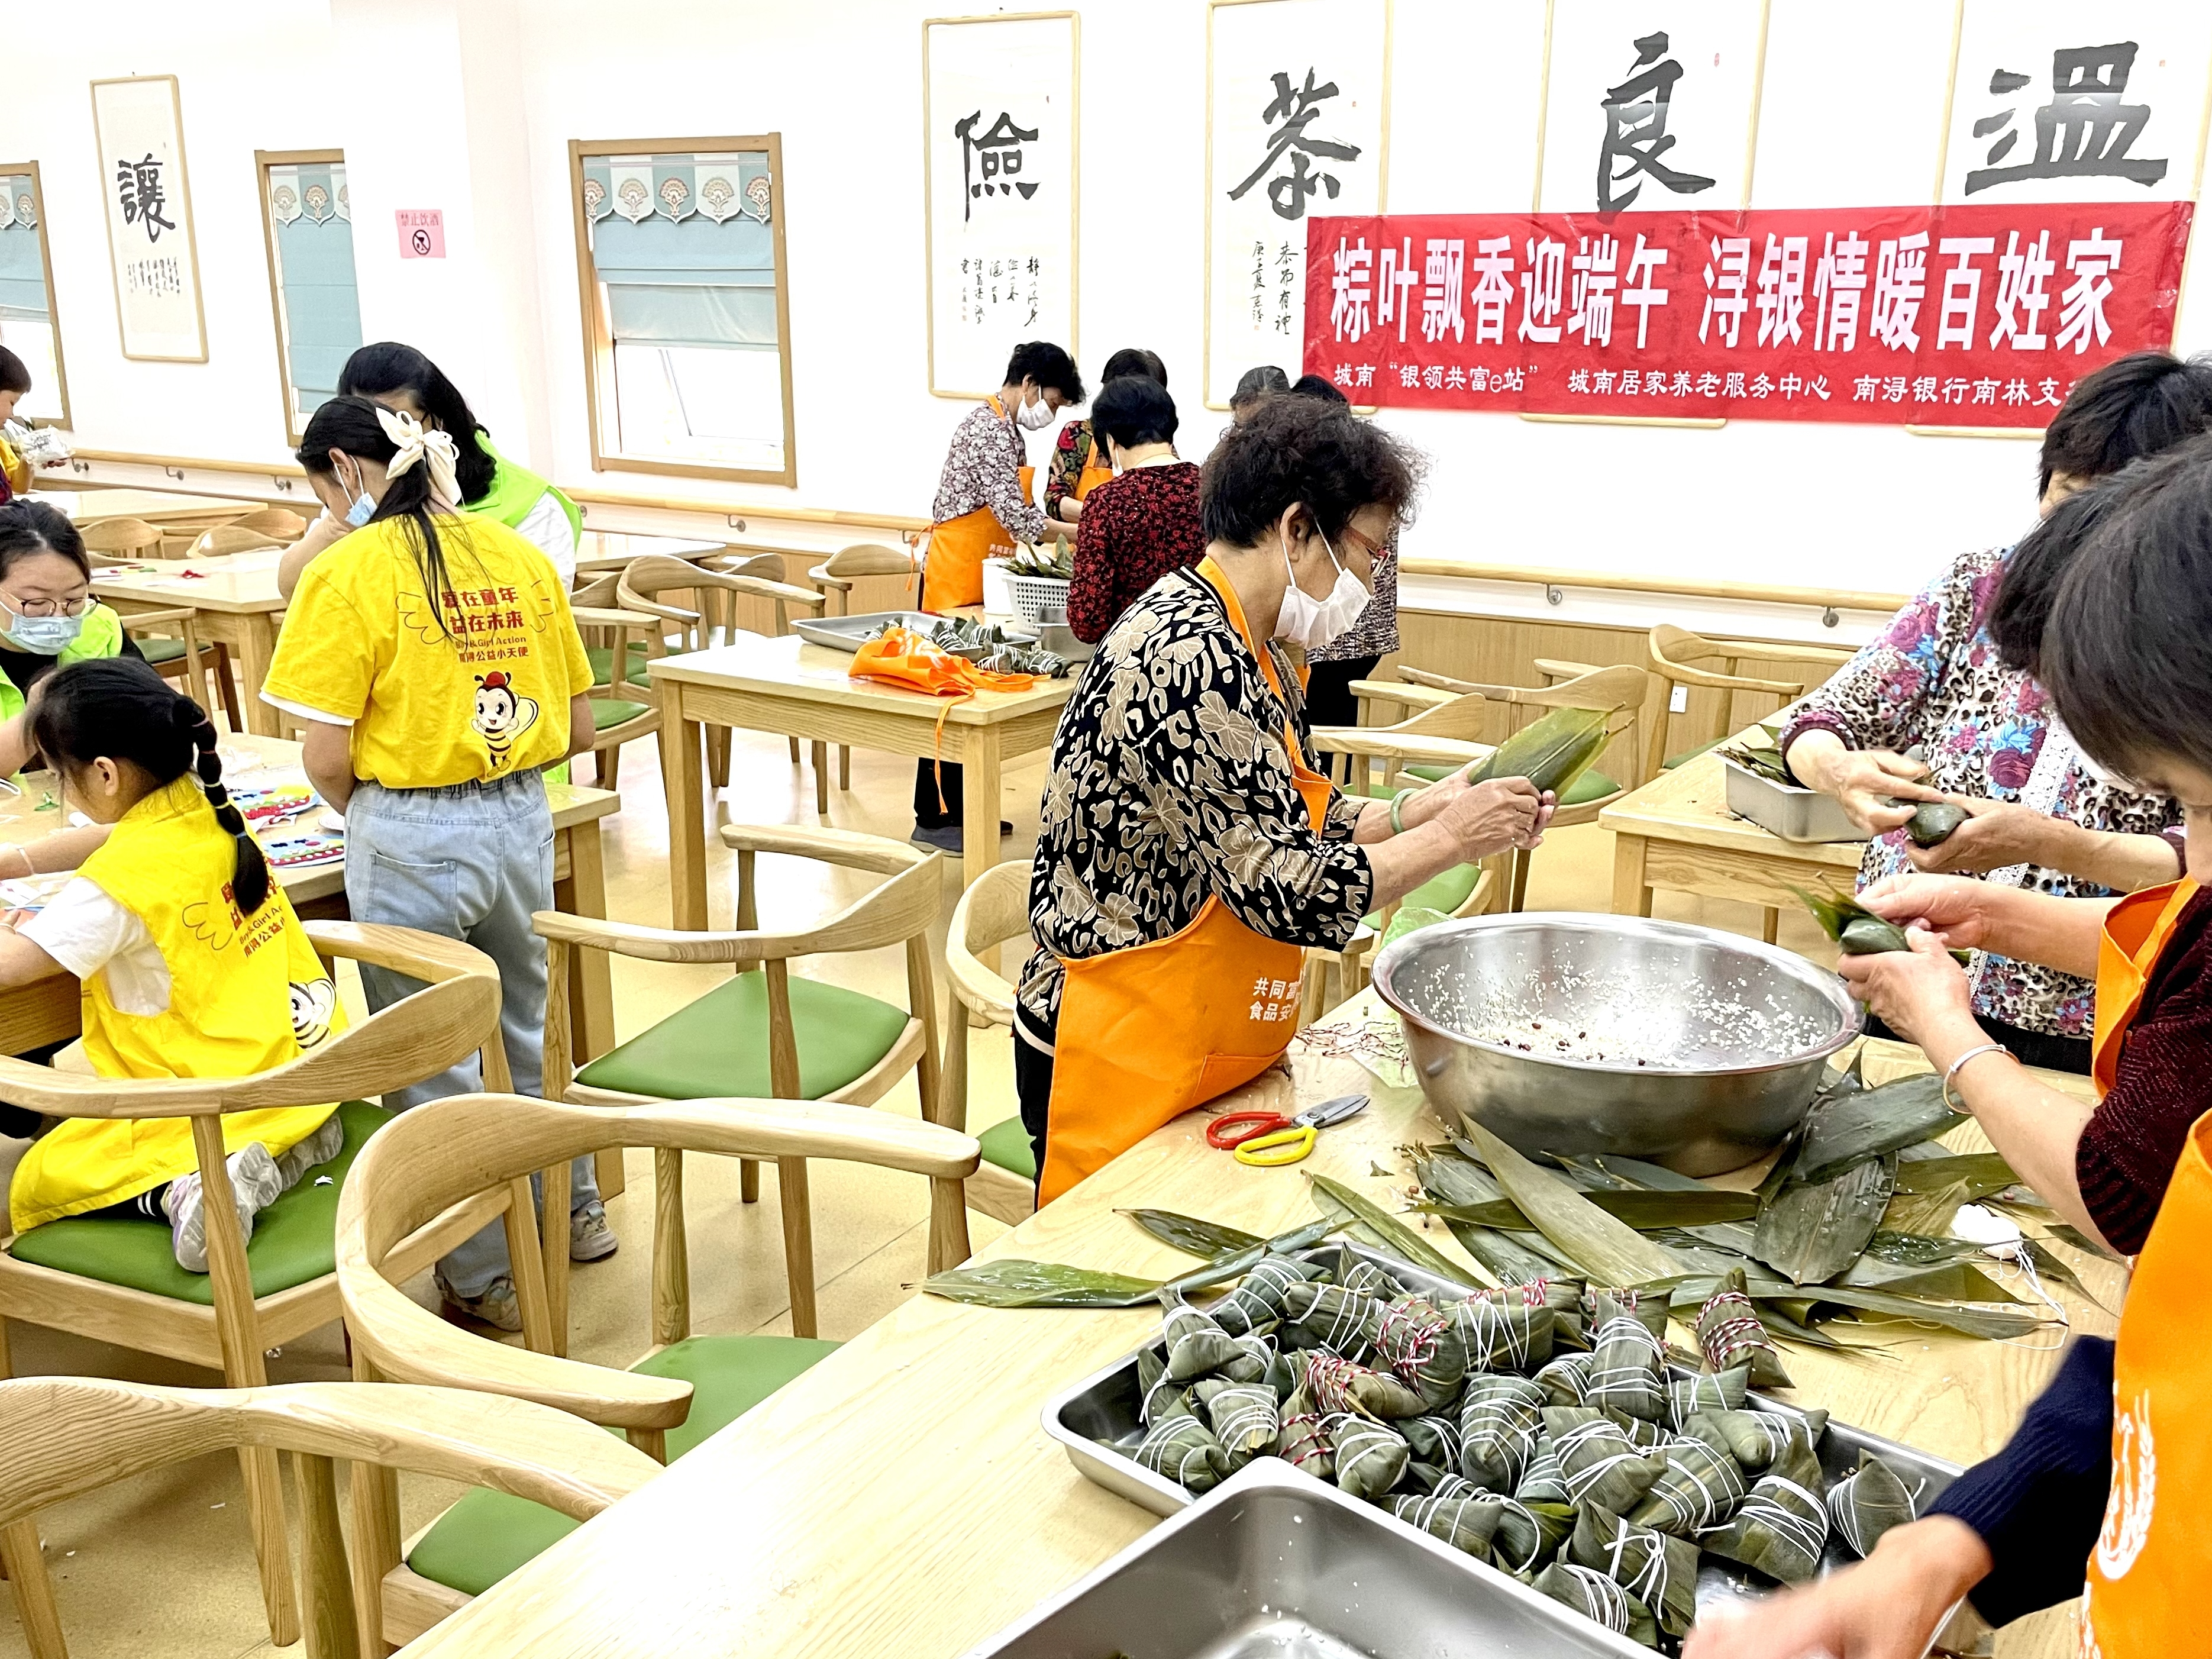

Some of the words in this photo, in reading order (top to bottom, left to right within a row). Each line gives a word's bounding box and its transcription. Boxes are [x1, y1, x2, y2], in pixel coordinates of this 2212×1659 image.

[1597, 31, 1716, 213] 良
[1330, 233, 1669, 350] 粽叶飘香迎端午
[1698, 227, 2123, 355] 浔银情暖百姓家
[1567, 368, 1832, 401] 城南居家养老服务中心
[449, 610, 525, 634] 益在未来
[496, 635, 527, 645] Action
